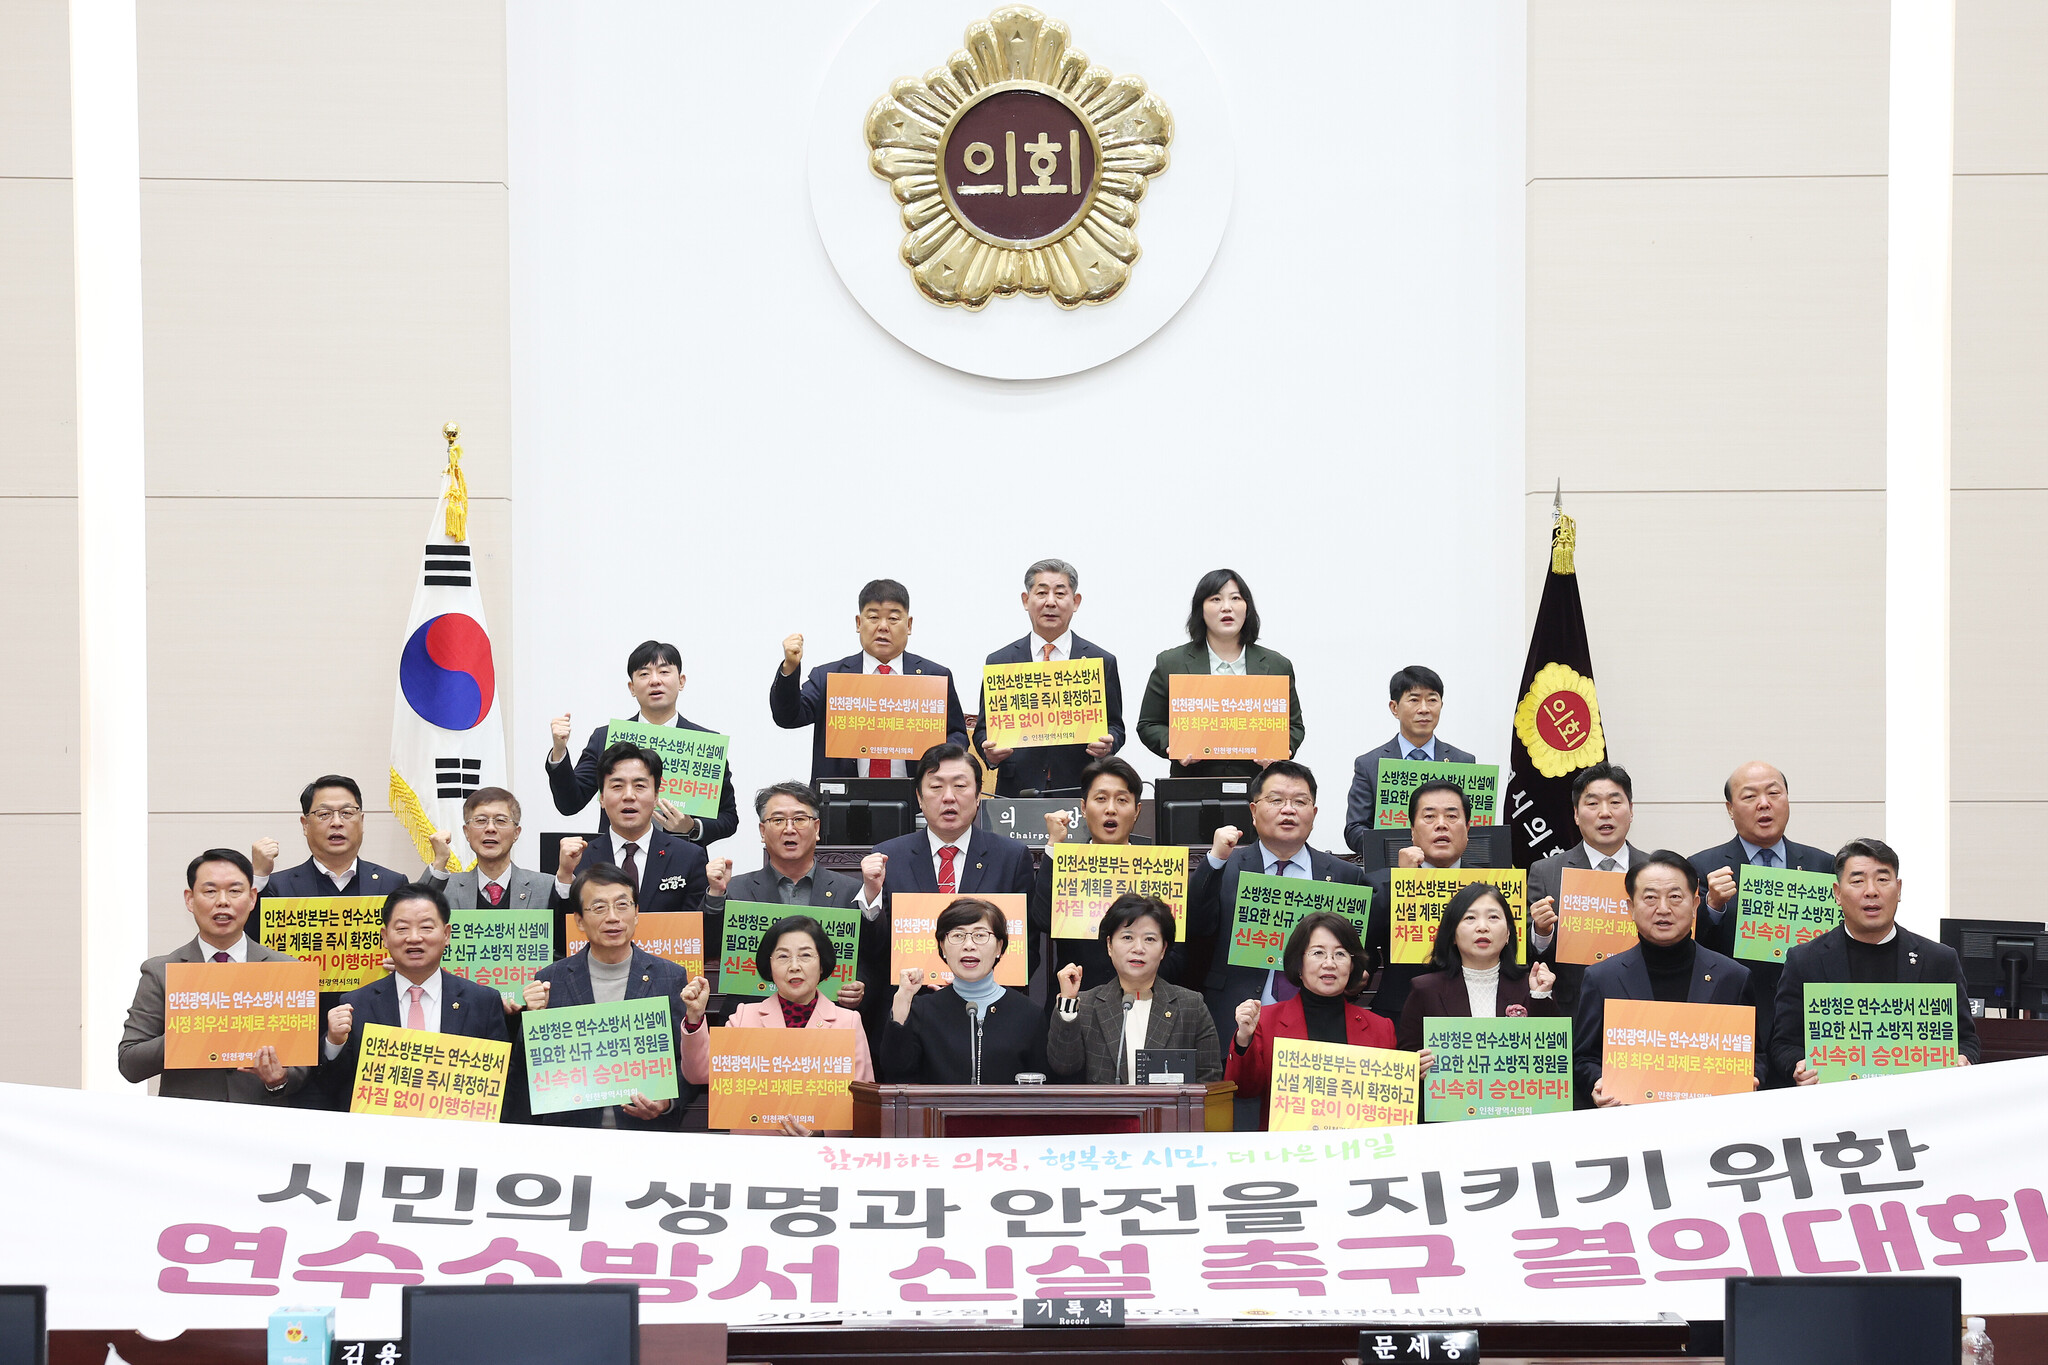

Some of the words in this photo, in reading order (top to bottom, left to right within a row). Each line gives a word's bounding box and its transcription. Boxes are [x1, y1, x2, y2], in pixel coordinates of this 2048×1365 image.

[957, 129, 1081, 197] 의회
[987, 671, 1052, 691] 인천소방본부는
[1054, 668, 1100, 687] 연수소방서
[829, 696, 877, 712] 인천광역시는
[879, 698, 919, 713] 연수소방서
[921, 699, 945, 714] 신설을
[989, 695, 1008, 712] 신설
[1010, 693, 1039, 711] 계획을
[1042, 691, 1061, 709] 즉시
[1063, 689, 1102, 707] 확정하고
[1172, 697, 1219, 712] 인천광역시는
[1221, 698, 1261, 712] 연수소방서
[1263, 698, 1287, 713] 신설을
[828, 715, 846, 730] 시정
[849, 716, 876, 731] 최우선
[877, 716, 905, 732] 과제로
[906, 717, 945, 733] 추진하라!
[990, 714, 1015, 730] 차질
[1019, 712, 1044, 728] 없이
[1048, 708, 1103, 727] 이행하라!
[1171, 716, 1189, 731] 시정
[1192, 717, 1218, 731] 최우선
[1220, 717, 1247, 732] 과제로
[1249, 717, 1287, 732] 추진하라!
[1543, 699, 1588, 748] 의회
[1032, 732, 1075, 741] 인천광역시의회
[870, 747, 913, 755] 인천광역시의회
[1010, 831, 1073, 841] Chairpen
[1057, 854, 1130, 874] 인천소방본부는
[1132, 857, 1184, 876] 연수소방서
[1056, 877, 1078, 896] 신설
[1081, 878, 1113, 897] 계획을
[1743, 877, 1784, 897] 소방청은
[1055, 900, 1084, 917] 차질
[1241, 885, 1282, 905] 소방청은
[1283, 890, 1334, 911] 연수소방서
[1335, 896, 1367, 915] 신설에
[1563, 893, 1618, 914] 인천광역시는
[264, 909, 340, 928] 인천소방본부는
[1238, 905, 1271, 926] 필요한
[1272, 910, 1295, 928] 신규
[1395, 903, 1417, 921] 신설
[1741, 898, 1775, 918] 필요한
[1777, 902, 1799, 921] 신규
[1801, 905, 1834, 925] 소방직
[464, 923, 515, 939] 연수소방서
[518, 923, 549, 939] 신설에
[1395, 925, 1423, 942] 차질
[1561, 915, 1582, 932] 시정
[1584, 917, 1615, 935] 최우선
[1739, 920, 1790, 944] 신속히
[290, 932, 323, 951] 계획을
[326, 932, 348, 950] 즉시
[674, 938, 701, 955] 신설을
[894, 938, 914, 954] 시정
[1234, 927, 1285, 951] 신속히
[455, 944, 477, 961] 신규
[480, 944, 512, 961] 소방직
[516, 944, 549, 961] 정원을
[169, 991, 230, 1009] 인천광역시는
[233, 991, 283, 1009] 연수소방서
[286, 990, 316, 1008] 신설을
[1809, 998, 1854, 1016] 소방청은
[1857, 998, 1915, 1016] 연수소방서
[1918, 998, 1952, 1016] 신설에
[168, 1015, 191, 1034] 시정
[194, 1015, 229, 1033] 최우선
[231, 1014, 266, 1033] 과제로
[268, 1014, 316, 1032] 추진하라!
[528, 1021, 573, 1043] 소방청은
[575, 1014, 631, 1038] 연수소방서
[633, 1010, 667, 1031] 신설에
[1809, 1021, 1846, 1040] 필요한
[1849, 1021, 1873, 1040] 신규
[1877, 1021, 1913, 1040] 소방직
[1917, 1021, 1954, 1040] 정원을
[1428, 1032, 1473, 1049] 소방청은
[1476, 1032, 1531, 1049] 연수소방서
[1535, 1032, 1567, 1049] 신설에
[1606, 1027, 1667, 1048] 인천광역시는
[1669, 1030, 1719, 1051] 연수소방서
[1722, 1033, 1752, 1052] 신설을
[364, 1036, 446, 1066] 인천소방본부는
[446, 1047, 506, 1074] 연수소방서
[530, 1044, 567, 1067] 필요한
[568, 1041, 593, 1062] 신규
[595, 1037, 631, 1059] 소방직
[634, 1033, 670, 1055] 정원을
[1809, 1046, 1866, 1066] 신속히
[1872, 1046, 1955, 1067] 승인하라!
[712, 1055, 770, 1072] 인천광역시는
[772, 1056, 820, 1073] 연수소방서
[823, 1056, 852, 1074] 신설을
[1277, 1049, 1357, 1075] 인천소방본부는
[1359, 1058, 1416, 1082] 연수소방서
[1467, 1055, 1491, 1073] 신규
[1494, 1055, 1529, 1073] 소방직
[1533, 1055, 1568, 1073] 정원을
[1605, 1050, 1628, 1069] 시정
[1631, 1052, 1665, 1071] 최우선
[1667, 1054, 1702, 1074] 과제로
[1703, 1056, 1752, 1076] 추진하라!
[360, 1061, 387, 1083] 신설
[387, 1064, 425, 1089] 계획을
[425, 1070, 452, 1092] 즉시
[451, 1073, 501, 1099] 확정하고
[532, 1066, 588, 1093] 신속히
[592, 1056, 673, 1085] 승인하라!
[711, 1077, 733, 1095] 시정
[736, 1078, 769, 1096] 최우선
[770, 1078, 804, 1096] 과제로
[1276, 1072, 1300, 1093] 신설
[1302, 1075, 1338, 1097] 계획을
[1341, 1079, 1365, 1100] 즉시
[1367, 1082, 1415, 1106] 확정하고
[1429, 1079, 1483, 1100] 신속히
[1489, 1079, 1569, 1099] 승인하라!
[356, 1085, 390, 1107] 차질
[392, 1089, 425, 1111] 없이
[427, 1094, 497, 1121] 이행하라!
[1274, 1094, 1306, 1115] 차질
[1310, 1098, 1341, 1119] 없이
[1346, 1102, 1413, 1127] 이행하라!
[1480, 1107, 1532, 1115] 인천광역시의회
[818, 1145, 940, 1171] 함께하는
[952, 1148, 1030, 1172] 의정,
[1038, 1145, 1133, 1170] 행복한
[1142, 1145, 1218, 1168] 시민,
[1226, 1149, 1256, 1164] 더
[1264, 1144, 1318, 1164] 나은
[1325, 1133, 1397, 1161] 내일
[257, 1162, 592, 1232] 시민의
[625, 1181, 962, 1239] 생명과
[990, 1180, 1318, 1238] 안전을
[1347, 1150, 1672, 1226] 지키기
[1707, 1128, 1930, 1203] 위한
[157, 1223, 840, 1303] 연수소방서
[889, 1243, 1156, 1302] 신설
[1201, 1235, 1465, 1298] 촉구
[1511, 1188, 2048, 1290] 결의대회
[1059, 1317, 1090, 1325] Record
